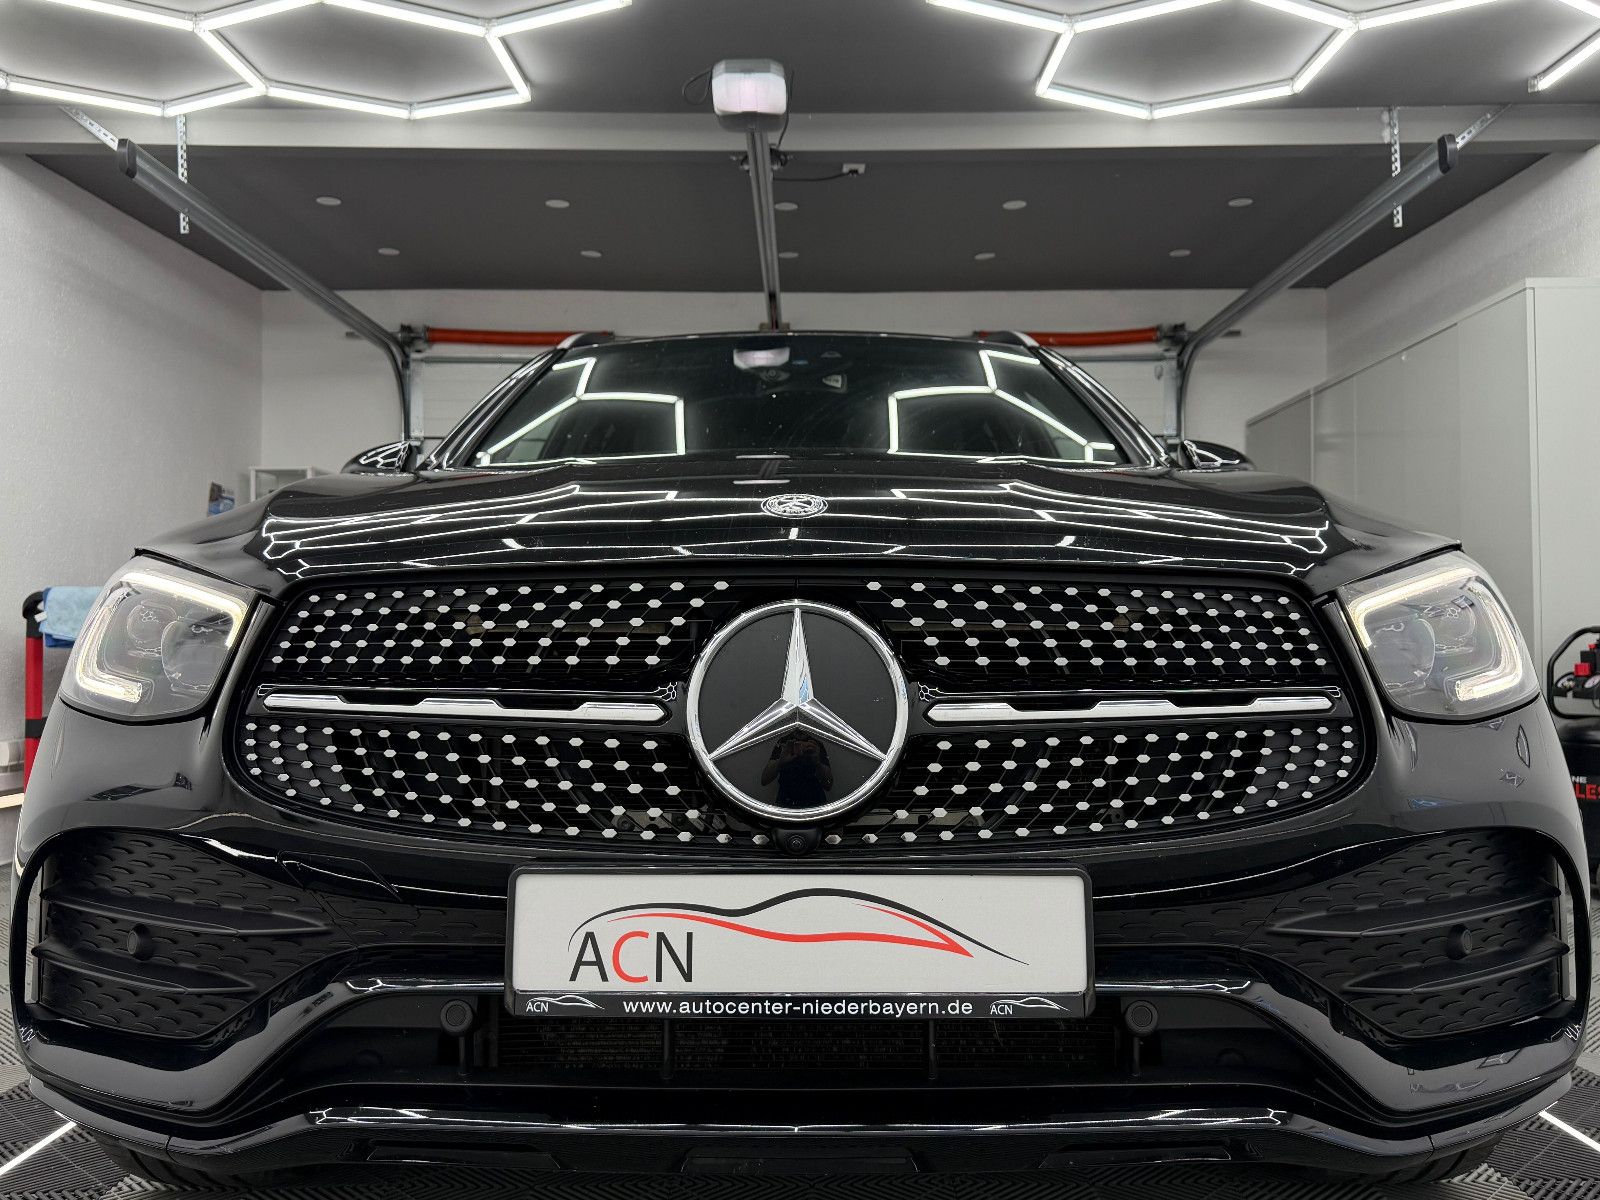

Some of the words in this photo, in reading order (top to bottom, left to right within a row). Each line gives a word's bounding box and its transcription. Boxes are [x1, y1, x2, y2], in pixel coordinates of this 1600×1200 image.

[569, 931, 693, 983] ACN
[525, 1001, 549, 1013] ACN
[623, 1000, 973, 1018] www.autocenter-niederbayern.de
[990, 1004, 1014, 1015] ACN
